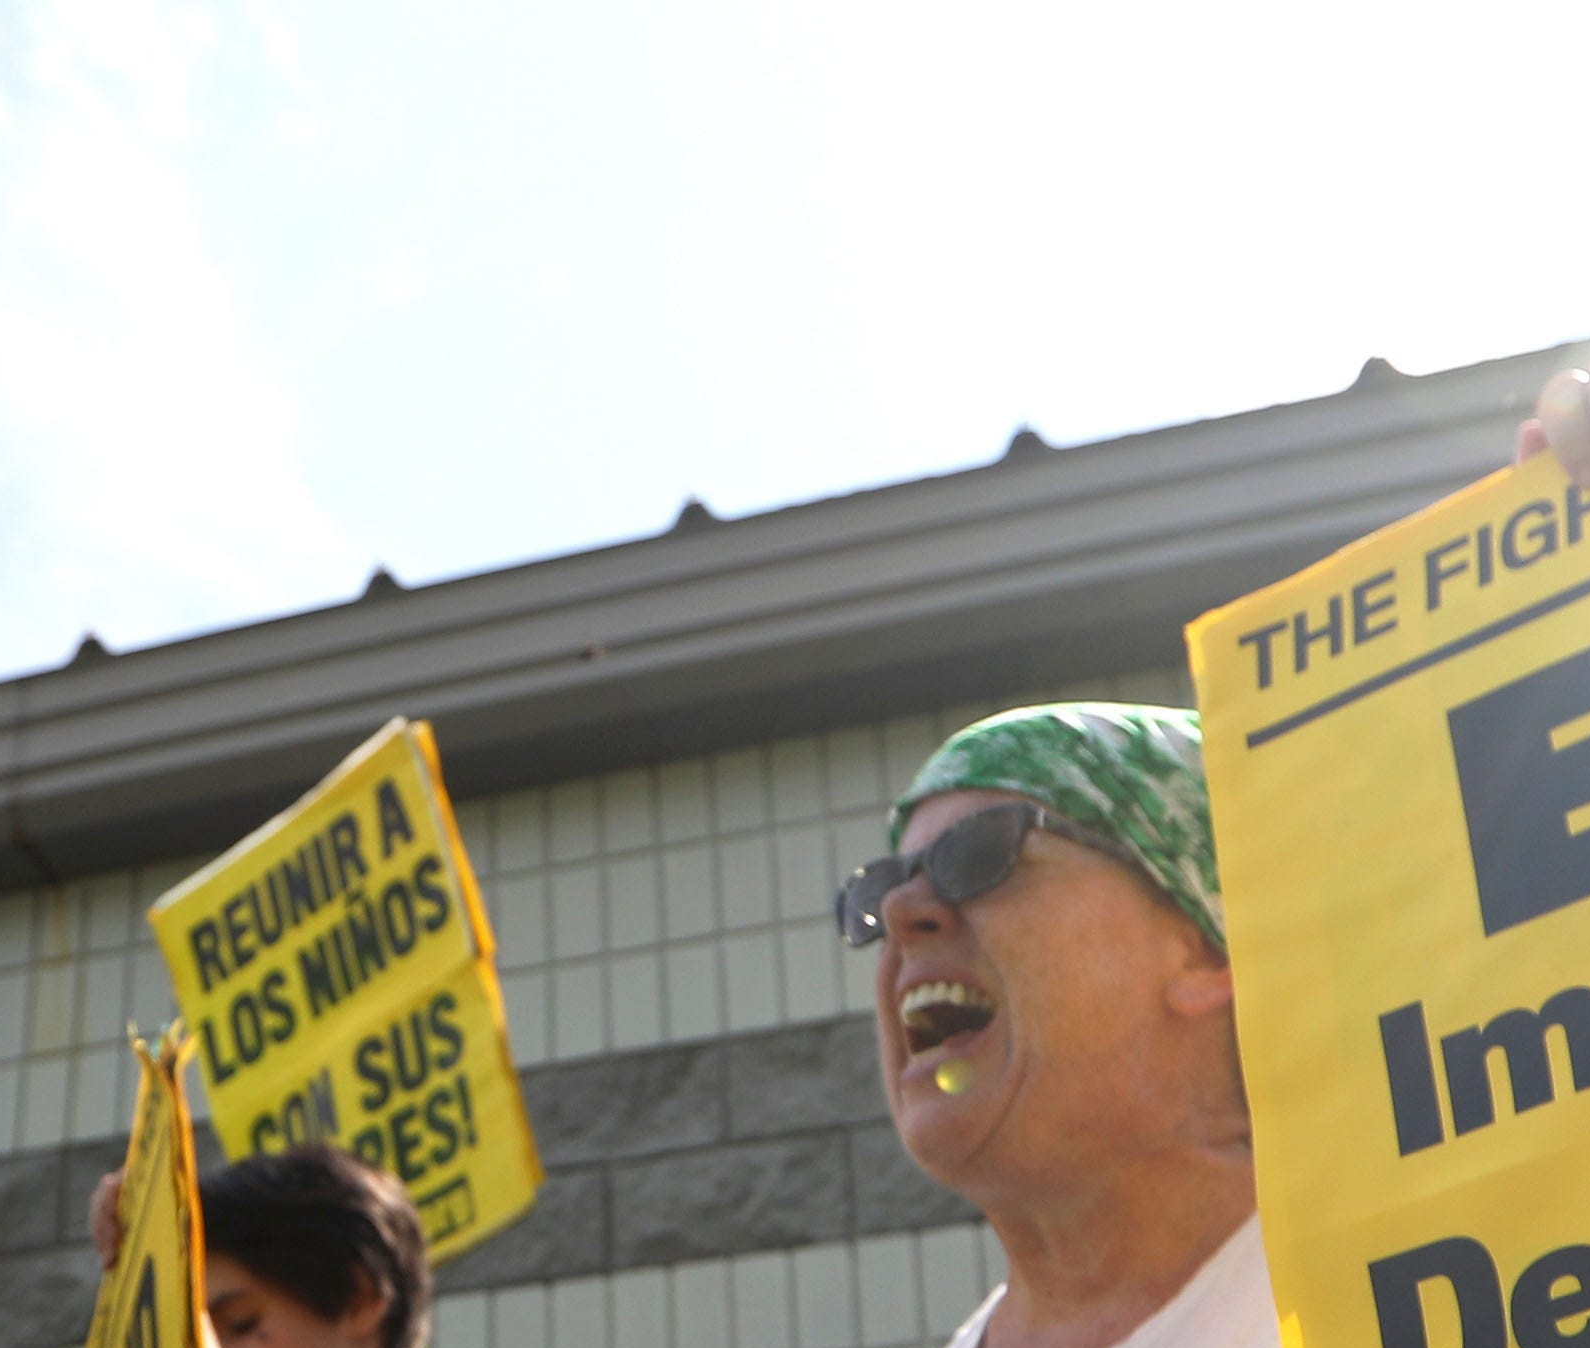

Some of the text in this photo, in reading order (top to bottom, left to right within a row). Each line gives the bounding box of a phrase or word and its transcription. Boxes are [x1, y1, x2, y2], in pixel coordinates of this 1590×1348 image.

[1238, 570, 1398, 690] THE
[187, 775, 416, 994] REUNIR A
[199, 856, 452, 1085] LOS NIÑOS
[354, 992, 465, 1113] SUS
